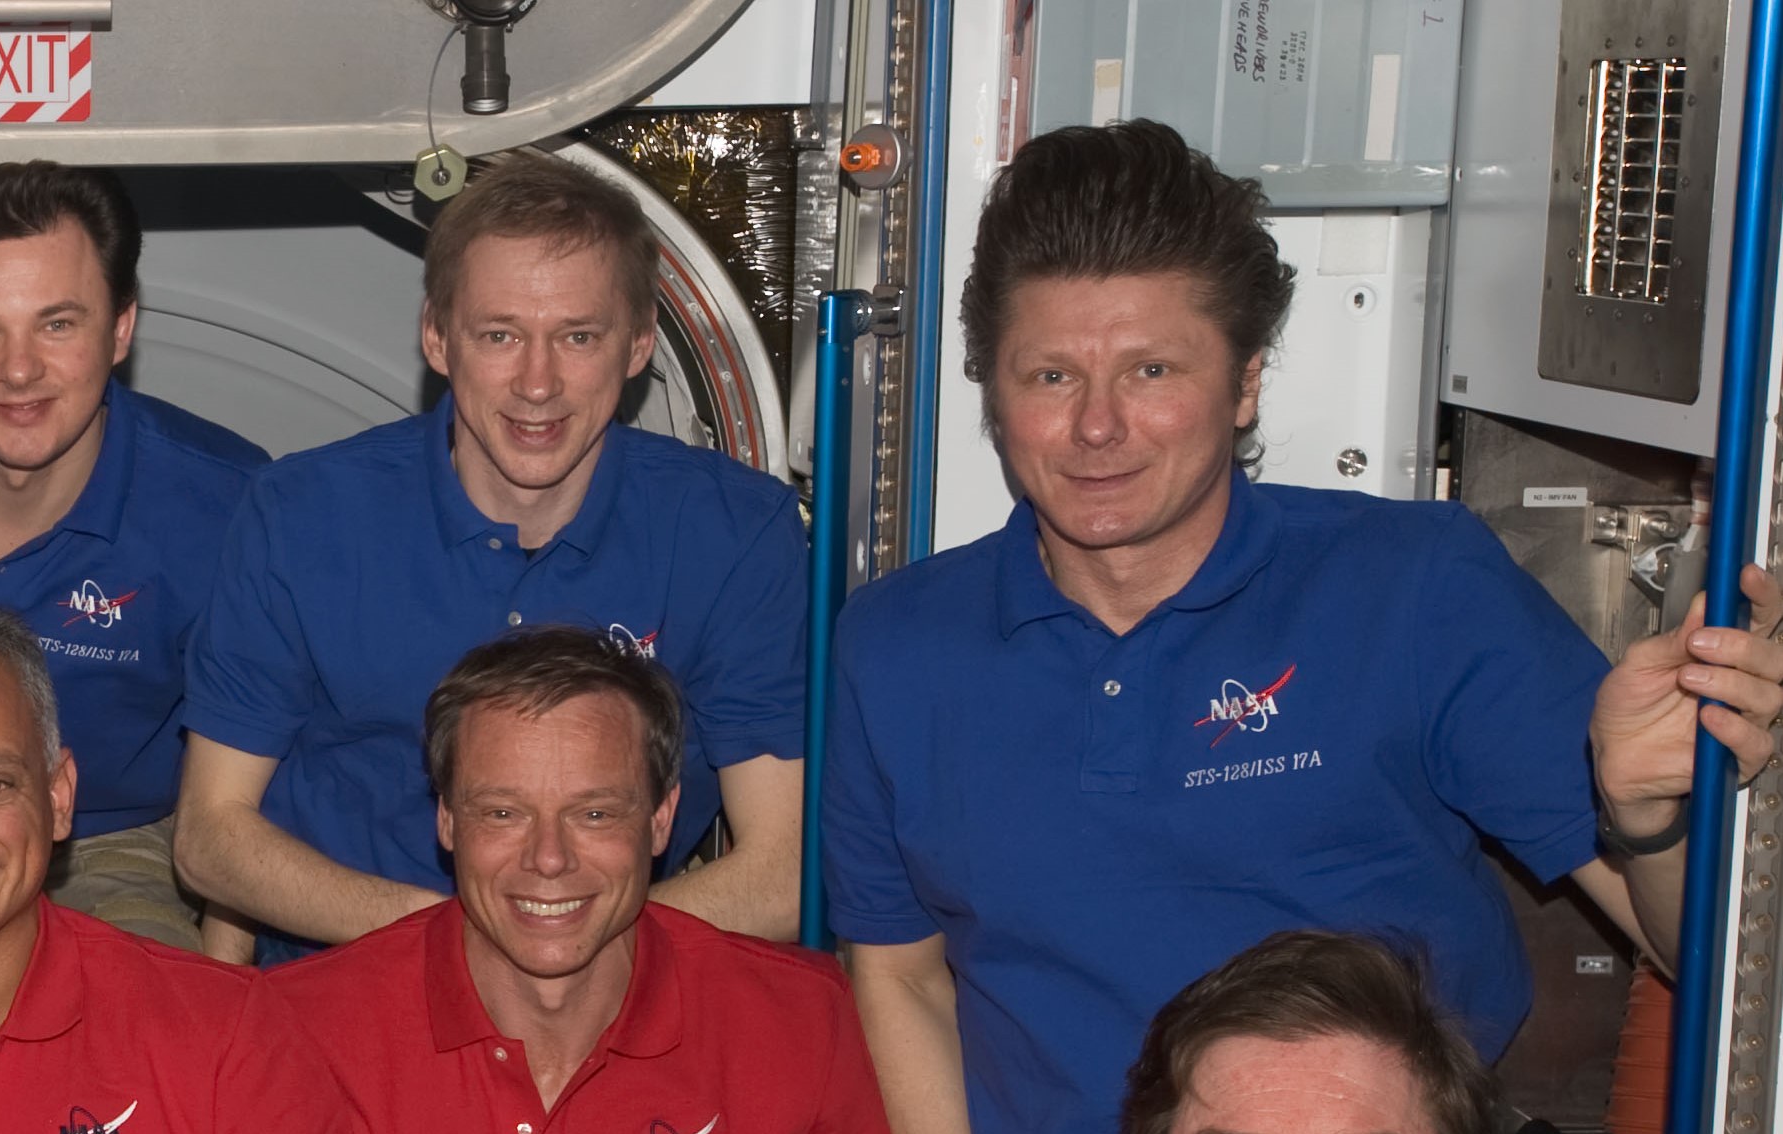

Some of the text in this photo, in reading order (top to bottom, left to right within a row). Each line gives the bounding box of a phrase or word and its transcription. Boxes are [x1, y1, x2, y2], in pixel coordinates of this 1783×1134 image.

[1233, 21, 1247, 74] HEADS
[1252, 0, 1269, 83] EWDRIVERS
[69, 590, 122, 621] NASA
[1210, 693, 1279, 721] NASA
[1184, 750, 1323, 788] STS-128/ISS 17A
